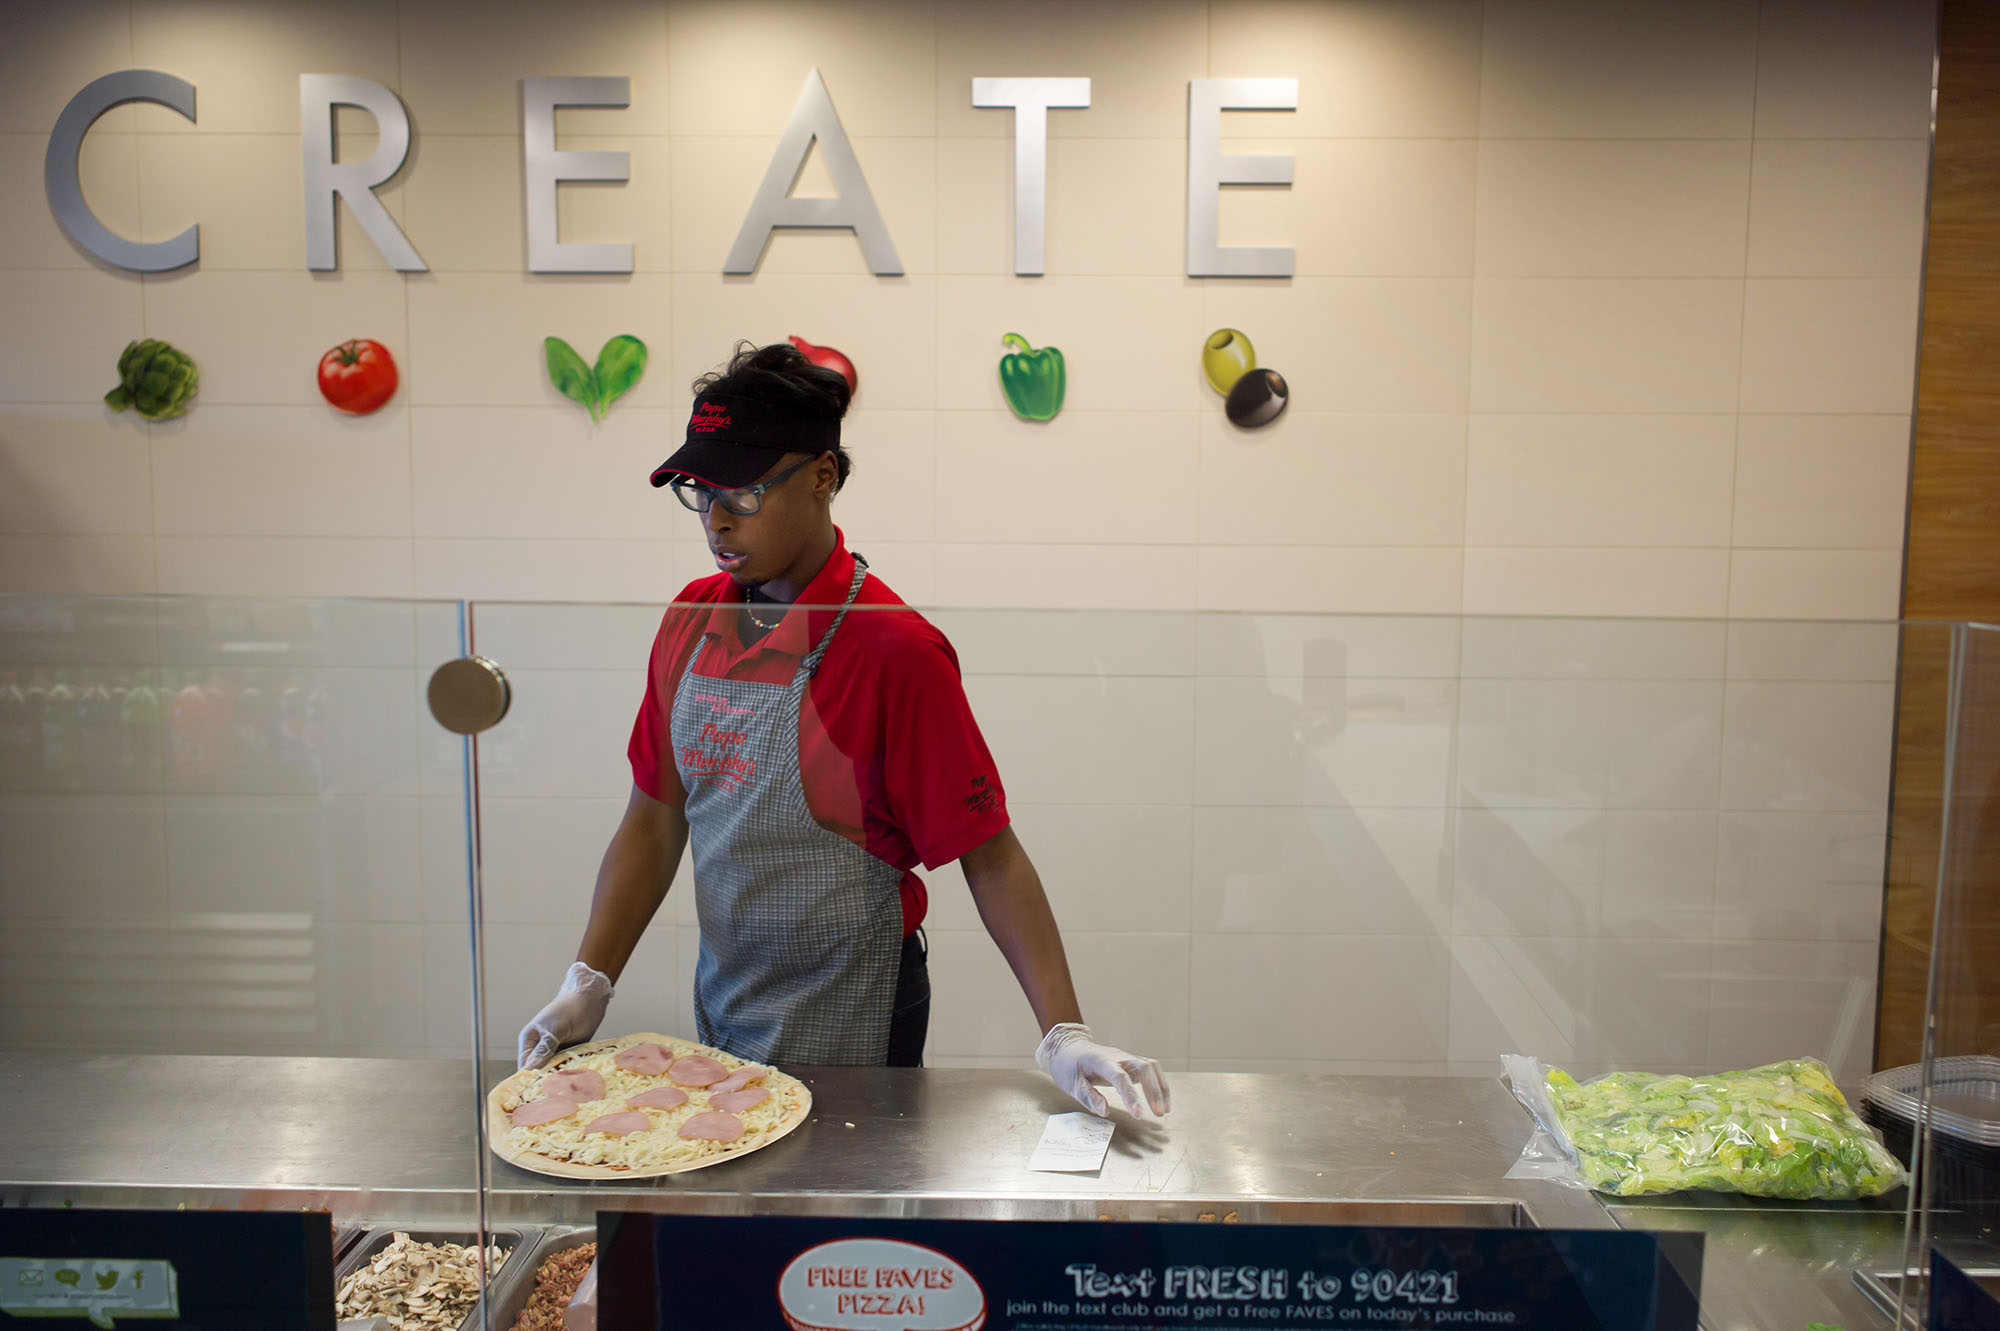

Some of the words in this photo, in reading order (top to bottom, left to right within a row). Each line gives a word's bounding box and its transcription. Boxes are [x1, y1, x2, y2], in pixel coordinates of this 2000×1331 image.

[45, 66, 1299, 277] CREATE
[699, 401, 727, 415] Papa
[700, 722, 747, 753] Papa
[680, 745, 757, 776] Murphy's
[807, 1266, 869, 1288] FREE
[875, 1267, 955, 1289] FAVES
[1065, 1263, 1157, 1298] Text
[1164, 1265, 1289, 1300] FRESH
[1297, 1270, 1342, 1300] to
[1351, 1267, 1460, 1303] 90421
[837, 1293, 925, 1315] PIZZA!
[1006, 1299, 1037, 1317] join
[1042, 1300, 1070, 1315] the
[1075, 1301, 1106, 1316] text
[1111, 1301, 1149, 1316] club
[1154, 1303, 1189, 1317] and
[1193, 1304, 1222, 1320] get
[1227, 1306, 1240, 1318] a
[1286, 1304, 1334, 1320] FAVES
[1339, 1307, 1362, 1320] on
[1367, 1306, 1431, 1323] today's
[1435, 1307, 1516, 1323] purchase
